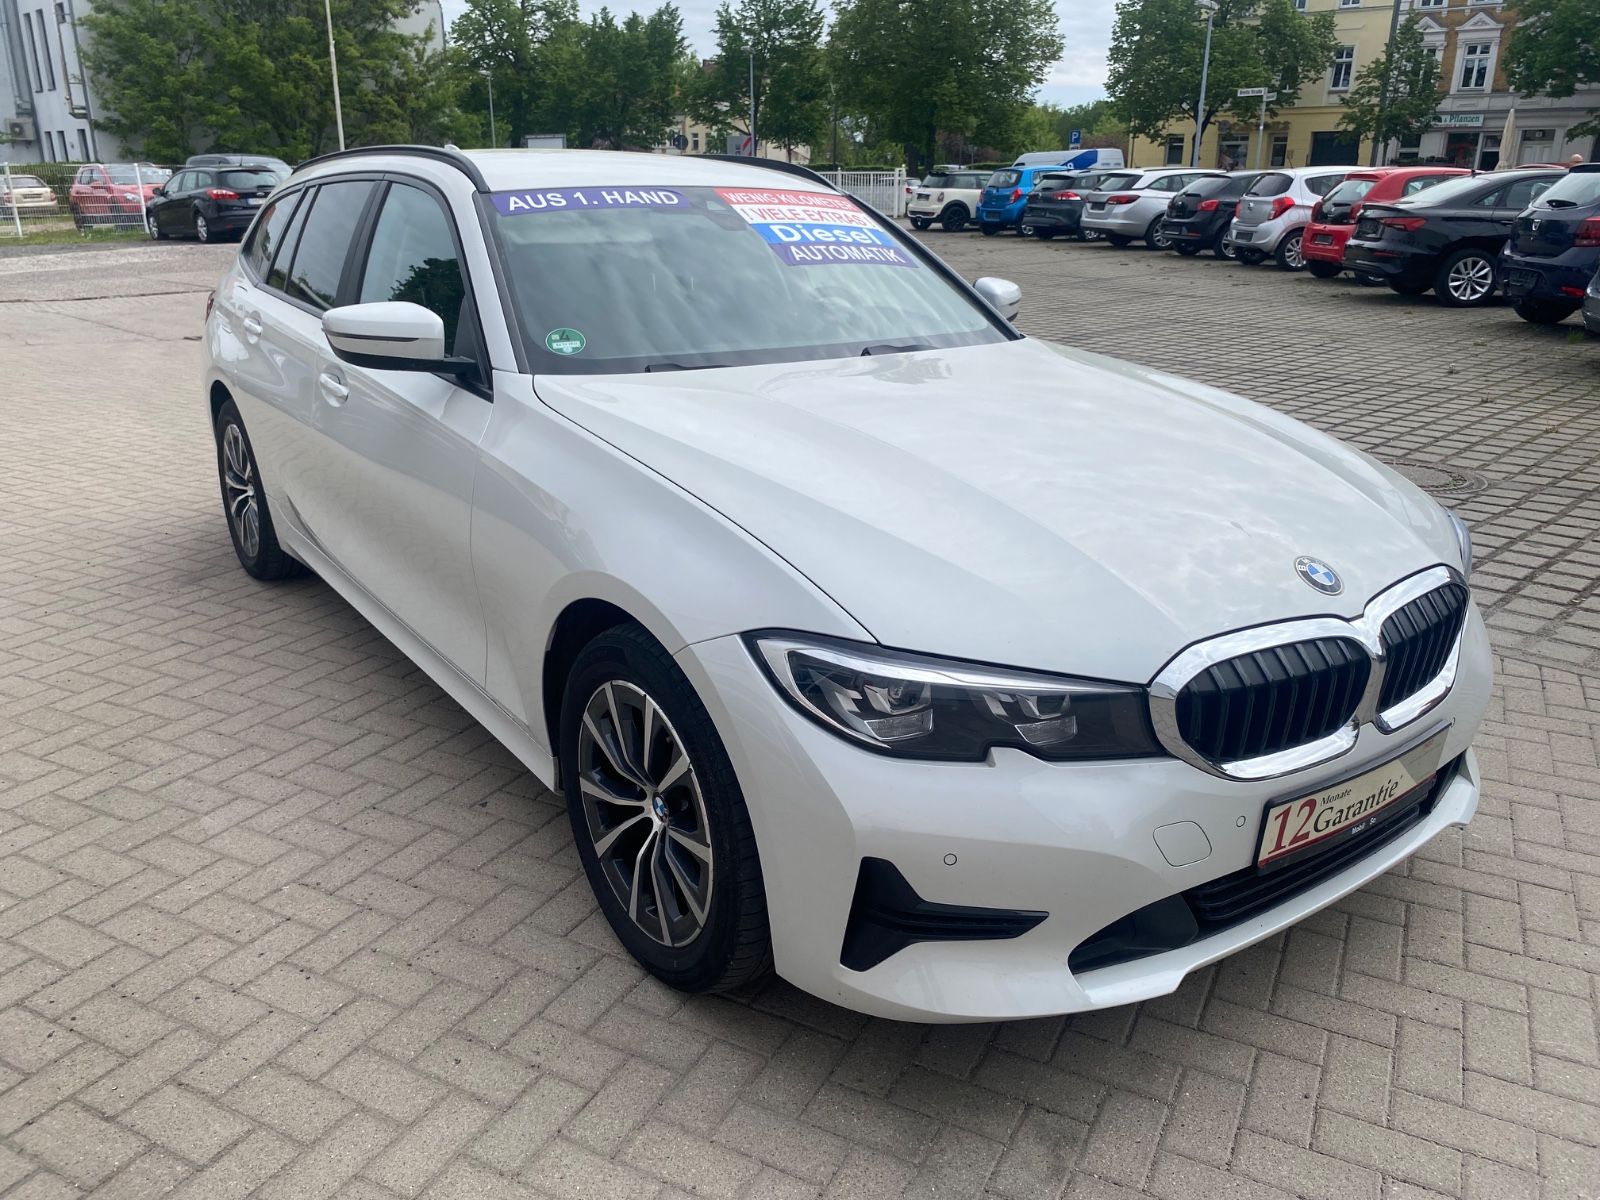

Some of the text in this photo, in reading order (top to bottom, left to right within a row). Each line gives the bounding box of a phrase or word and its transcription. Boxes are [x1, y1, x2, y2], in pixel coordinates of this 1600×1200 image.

[1449, 114, 1480, 123] Pflanzen
[1071, 131, 1079, 143] P
[509, 191, 679, 211] AUS 1. HAND
[723, 192, 858, 211] WENIG KILOMETER
[752, 208, 804, 221] VIELE
[805, 209, 866, 226] EXTRAS
[769, 224, 882, 245] Diesel
[790, 245, 906, 263] AUTOMATIK
[560, 330, 570, 341] 4
[1320, 788, 1352, 806] Monate
[1268, 798, 1317, 855] 12
